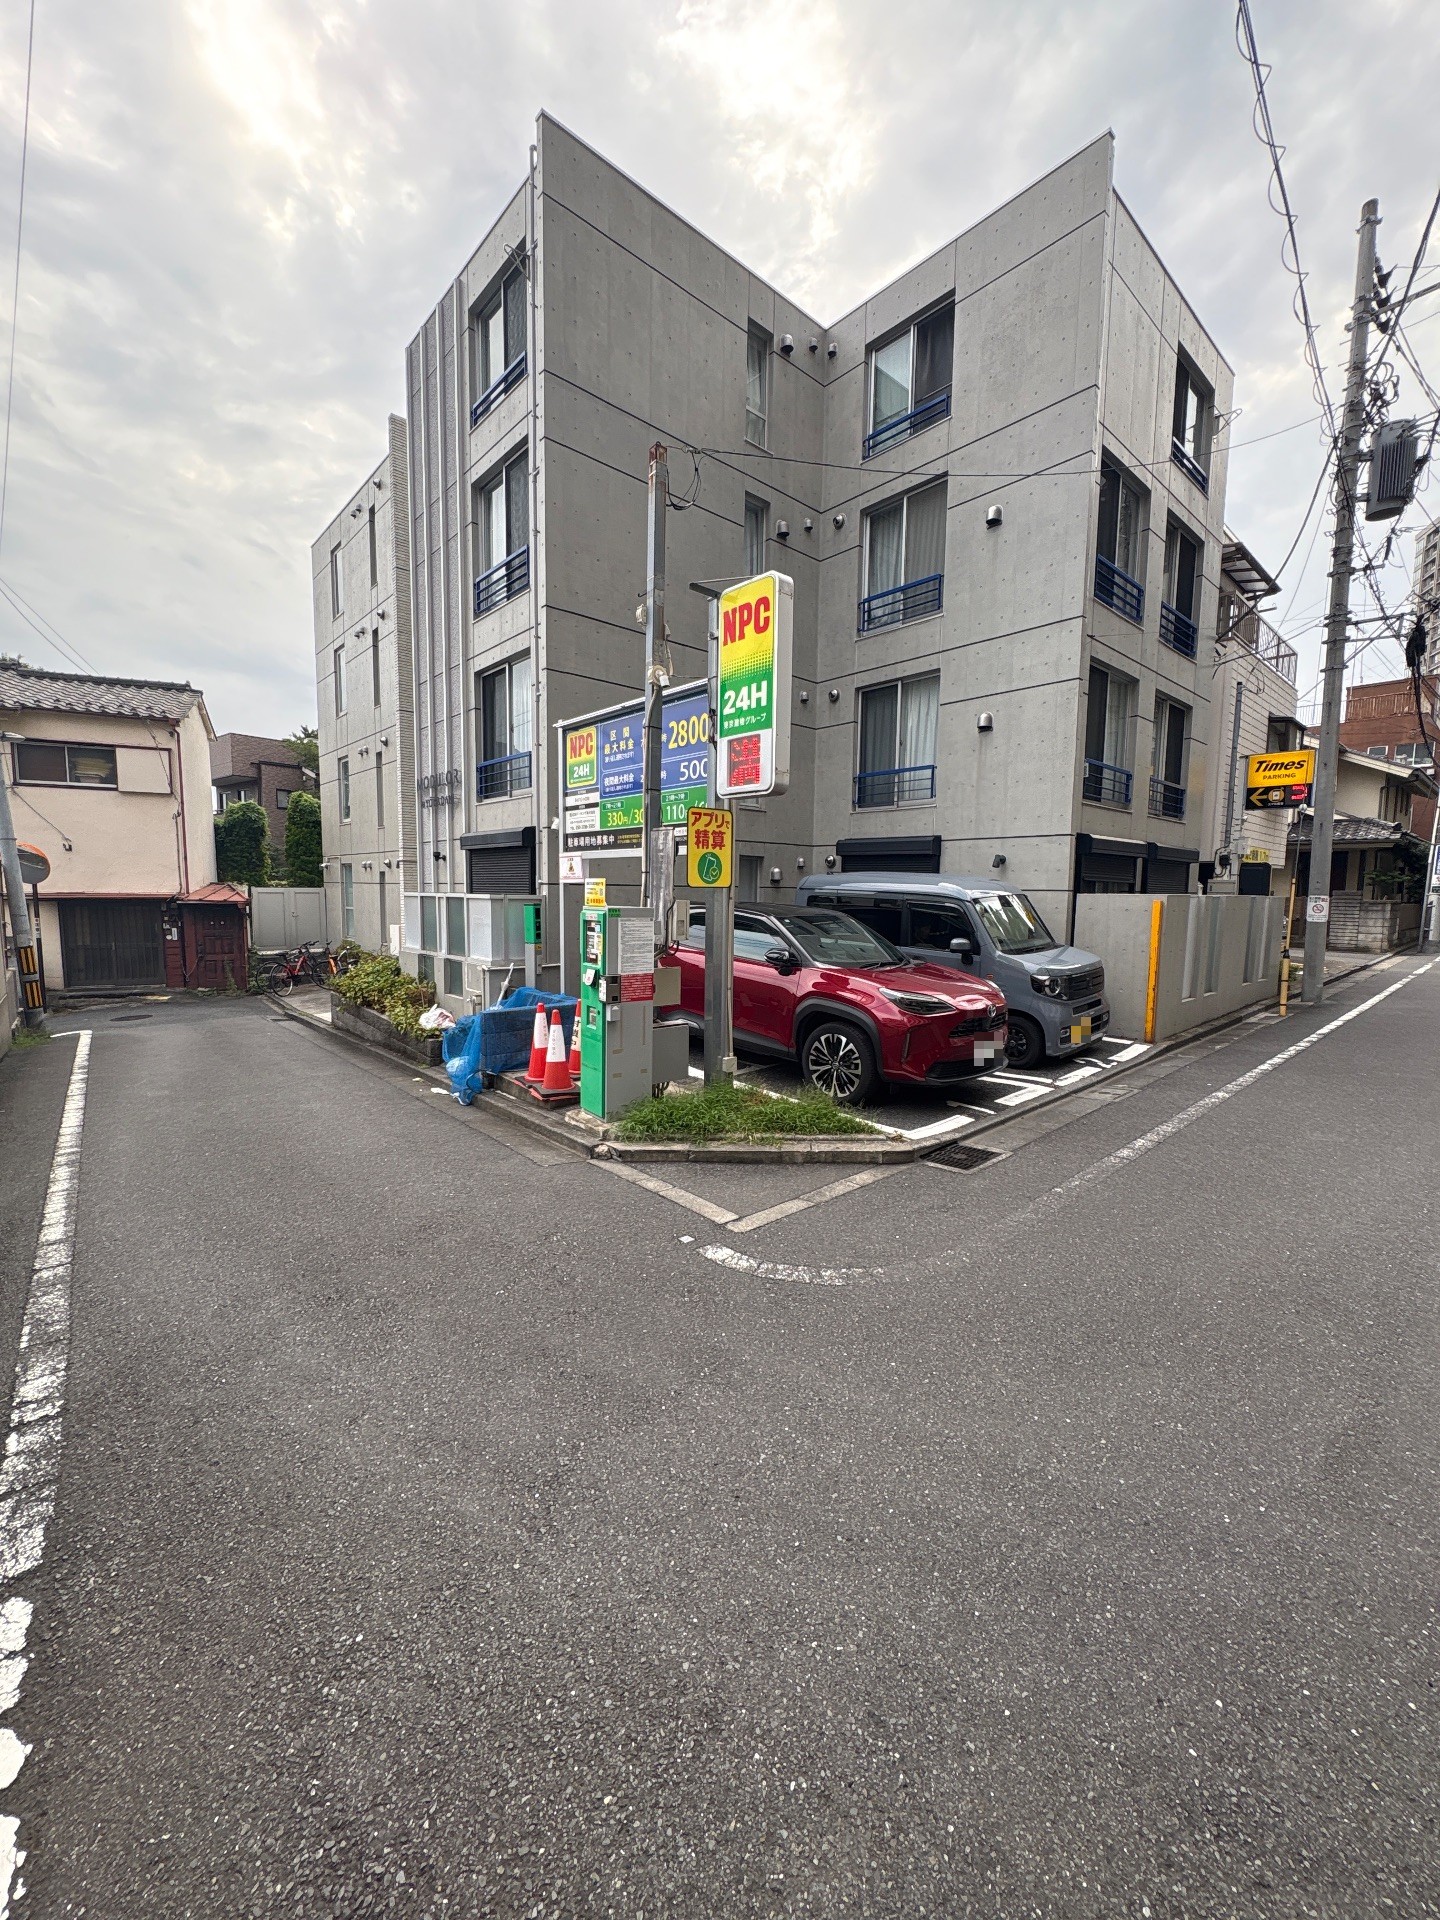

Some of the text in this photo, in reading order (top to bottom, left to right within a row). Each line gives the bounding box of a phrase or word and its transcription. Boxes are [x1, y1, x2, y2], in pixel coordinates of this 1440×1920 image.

[722, 596, 770, 647] NPC
[723, 680, 768, 715] 24H
[668, 712, 709, 749] 2800
[569, 732, 594, 760] NPC
[573, 763, 590, 778] 24H
[1254, 760, 1307, 773] Times
[691, 811, 731, 830] アプリで
[694, 828, 727, 851] 精算
